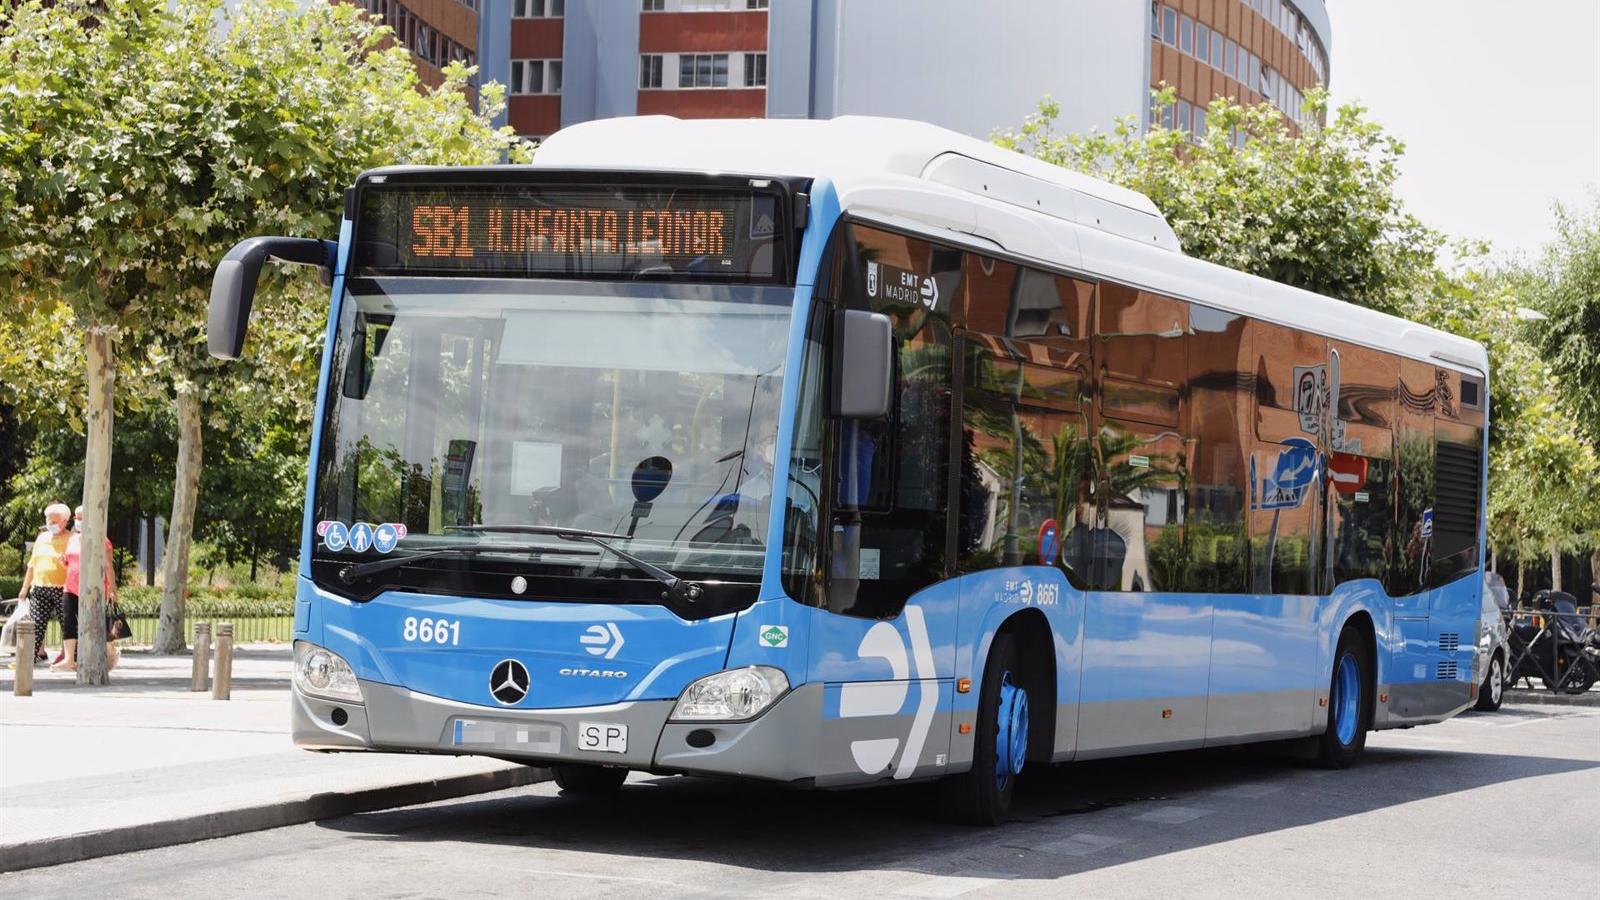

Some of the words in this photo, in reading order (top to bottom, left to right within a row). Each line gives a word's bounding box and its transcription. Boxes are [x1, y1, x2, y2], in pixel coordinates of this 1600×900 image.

[412, 206, 474, 257] SB1
[488, 209, 617, 253] H.INFANTA
[626, 210, 724, 254] LEONOR
[901, 272, 918, 286] EMT
[885, 285, 918, 304] MADRID
[1037, 584, 1059, 605] 8661
[403, 616, 460, 646] 8661
[764, 632, 784, 641] GNC
[559, 668, 628, 679] CITARO
